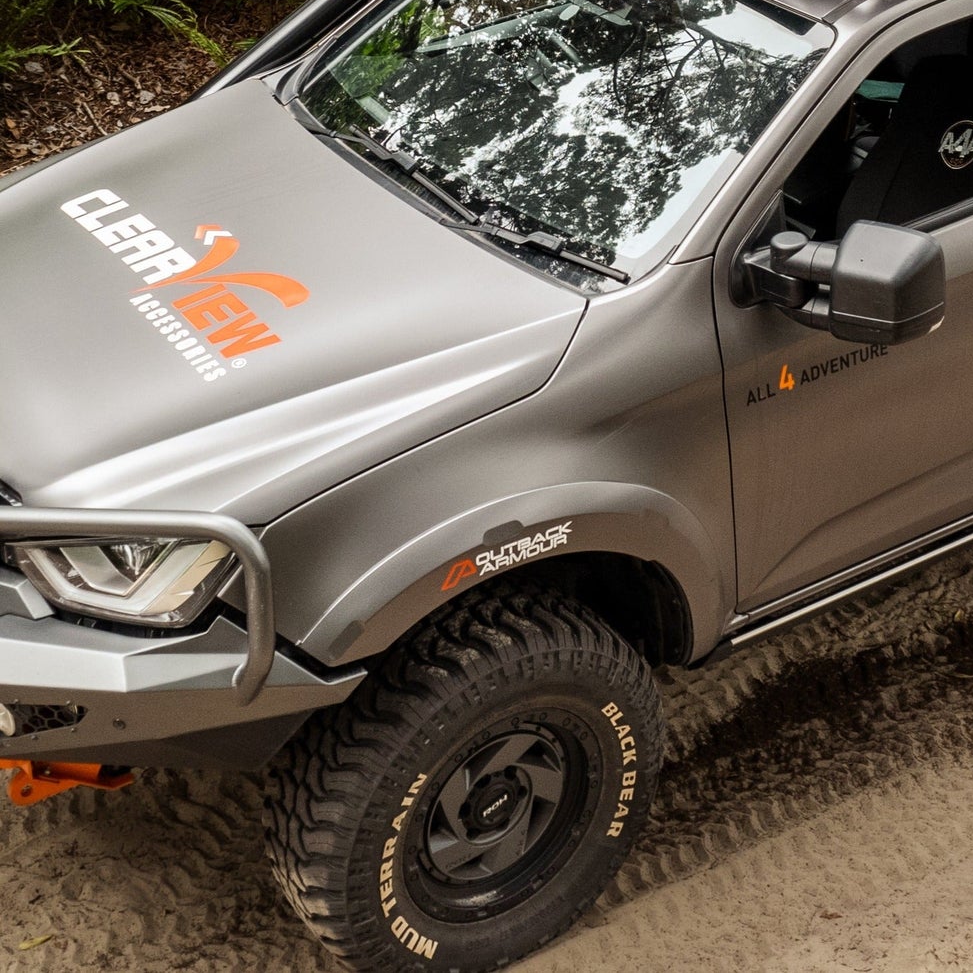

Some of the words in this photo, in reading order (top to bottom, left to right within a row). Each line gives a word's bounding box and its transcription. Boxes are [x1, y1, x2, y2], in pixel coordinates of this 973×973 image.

[60, 188, 311, 360] CLEARVIEW
[129, 293, 226, 382] ACCESSORIES
[746, 383, 776, 407] ALL
[779, 364, 796, 391] 4
[800, 343, 889, 385] ADVENTURE
[475, 521, 573, 566] OUTBACK
[480, 534, 568, 576] ARMOUR
[601, 701, 637, 766] BLACK
[606, 770, 637, 837] BEAR
[379, 773, 427, 918] TERRAIN
[391, 915, 439, 961] MUD
